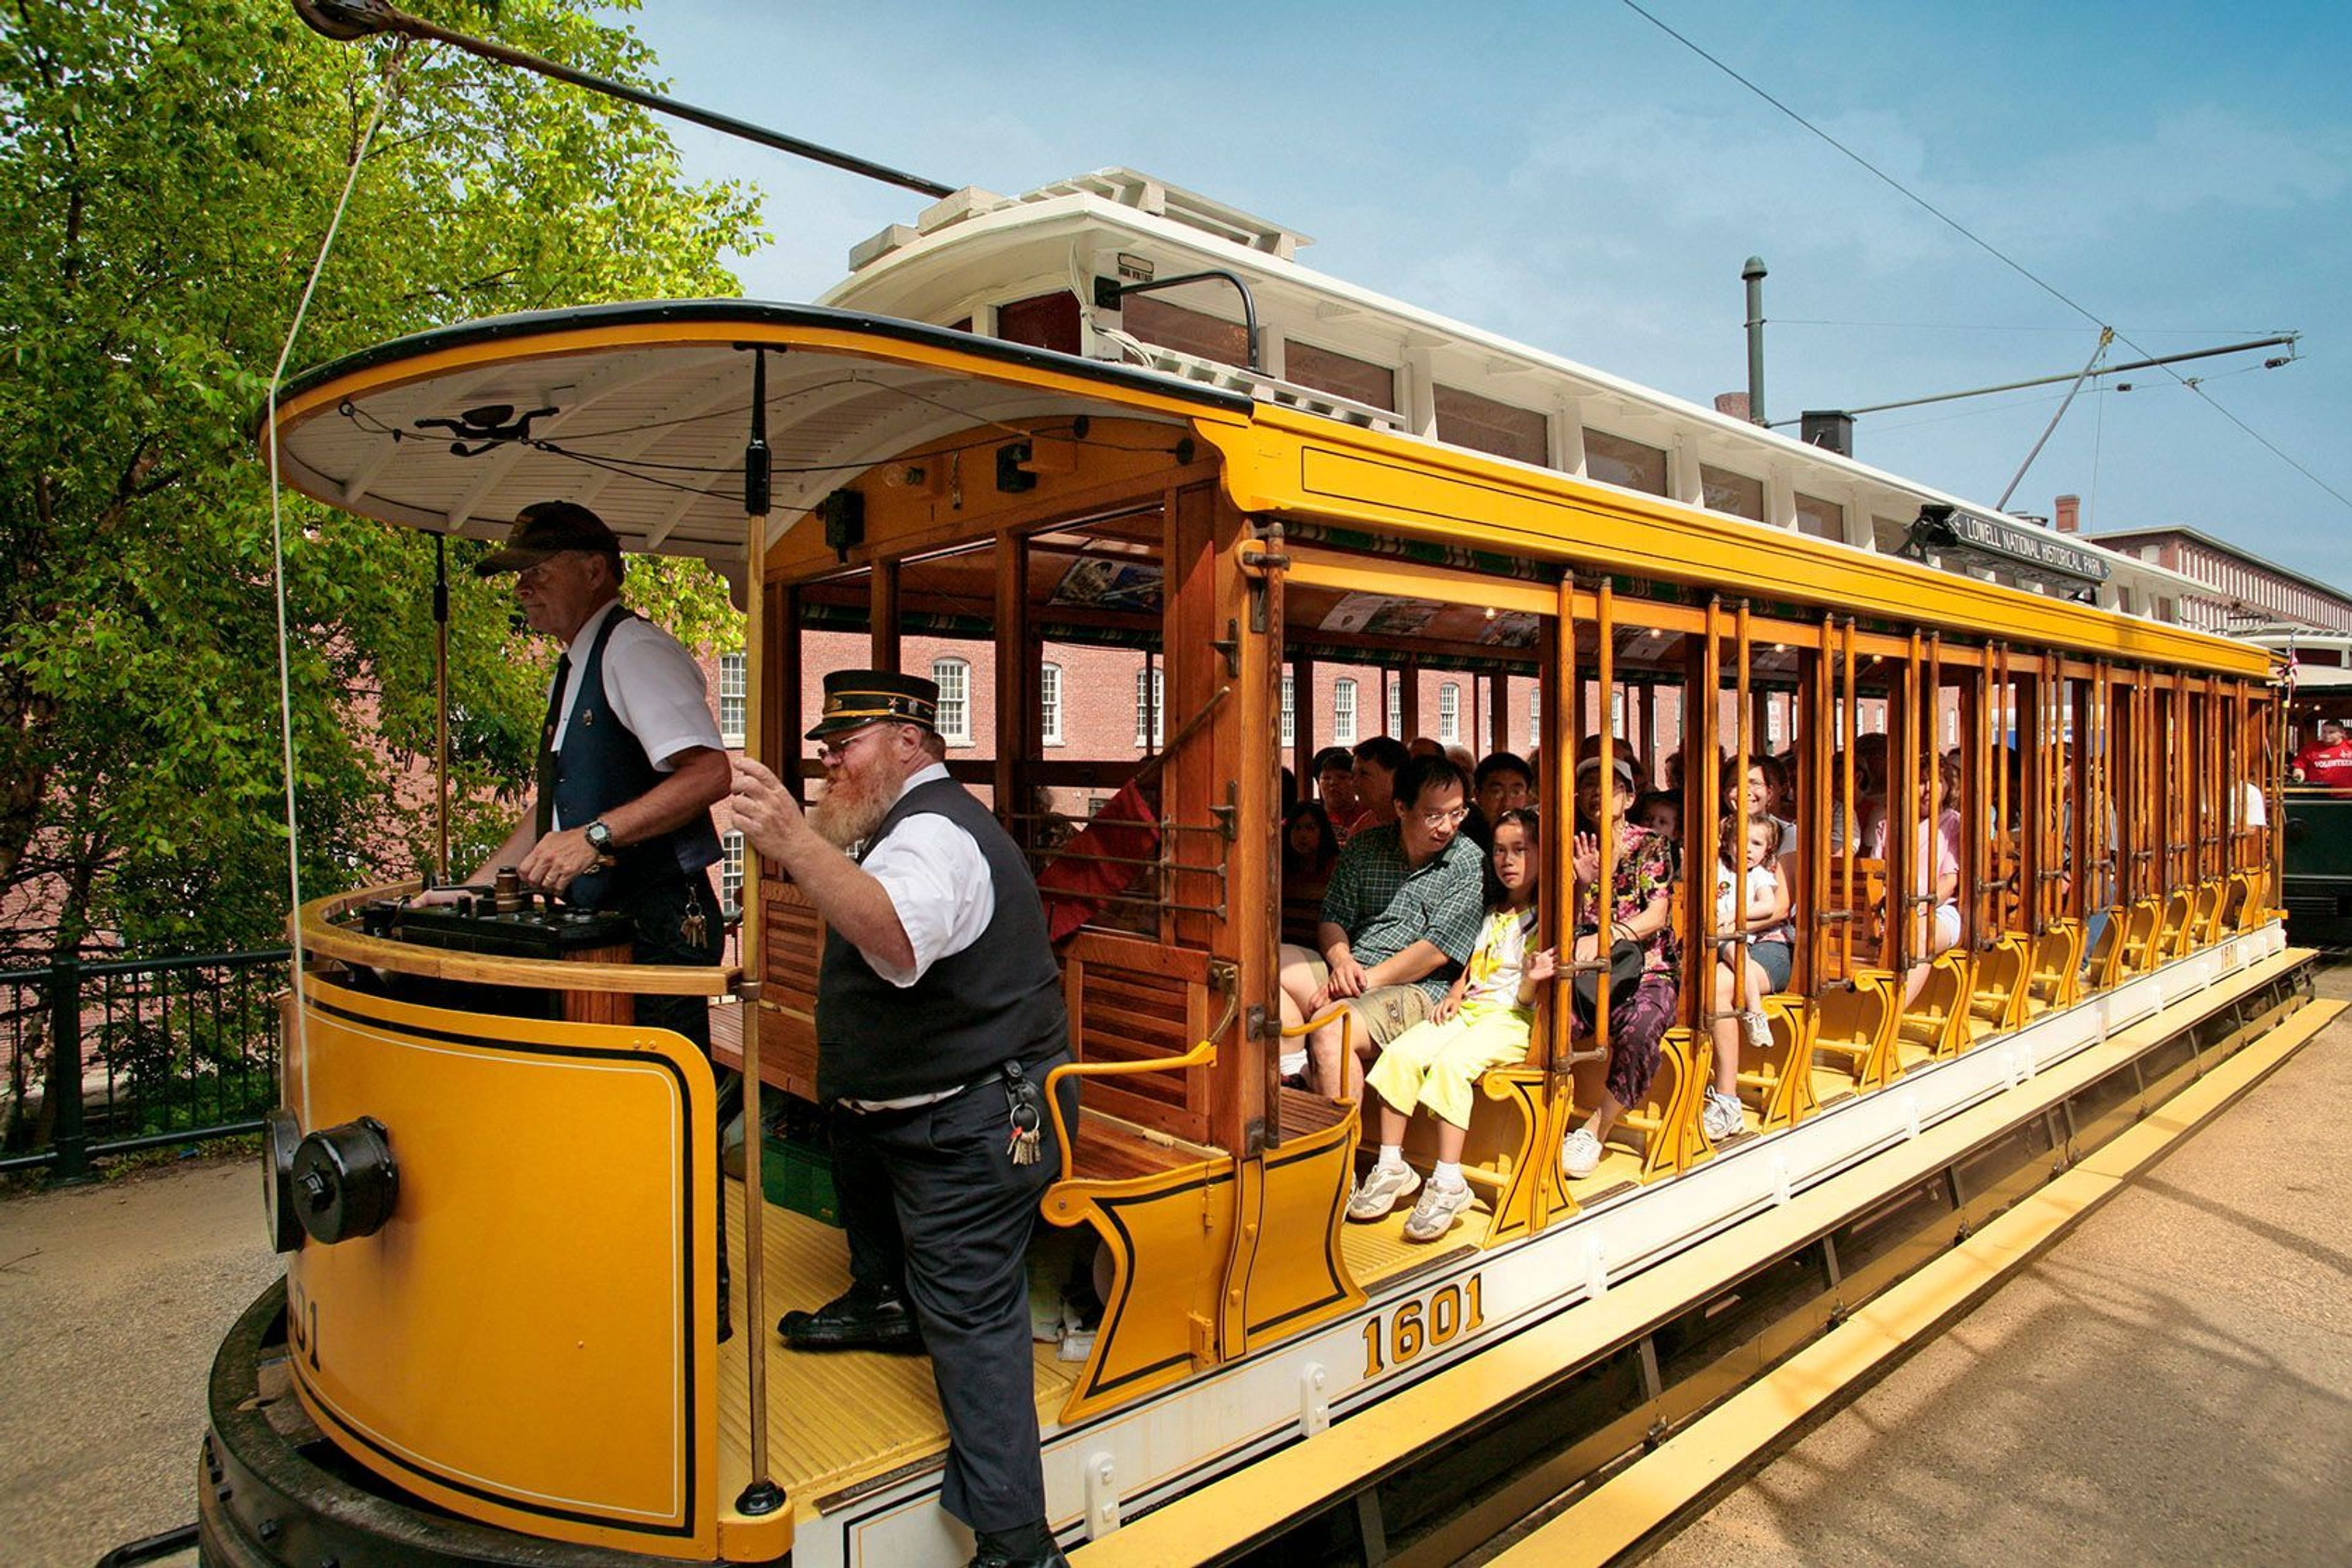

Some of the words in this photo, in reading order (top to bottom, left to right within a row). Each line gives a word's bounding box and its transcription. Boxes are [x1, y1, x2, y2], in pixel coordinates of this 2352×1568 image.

[1966, 518, 2001, 548] LOWELL
[2002, 529, 2041, 559] NATIONAL
[2041, 543, 2082, 571] HISTORICAL
[2082, 556, 2101, 577] PARK
[1362, 1272, 1484, 1379] 1601
